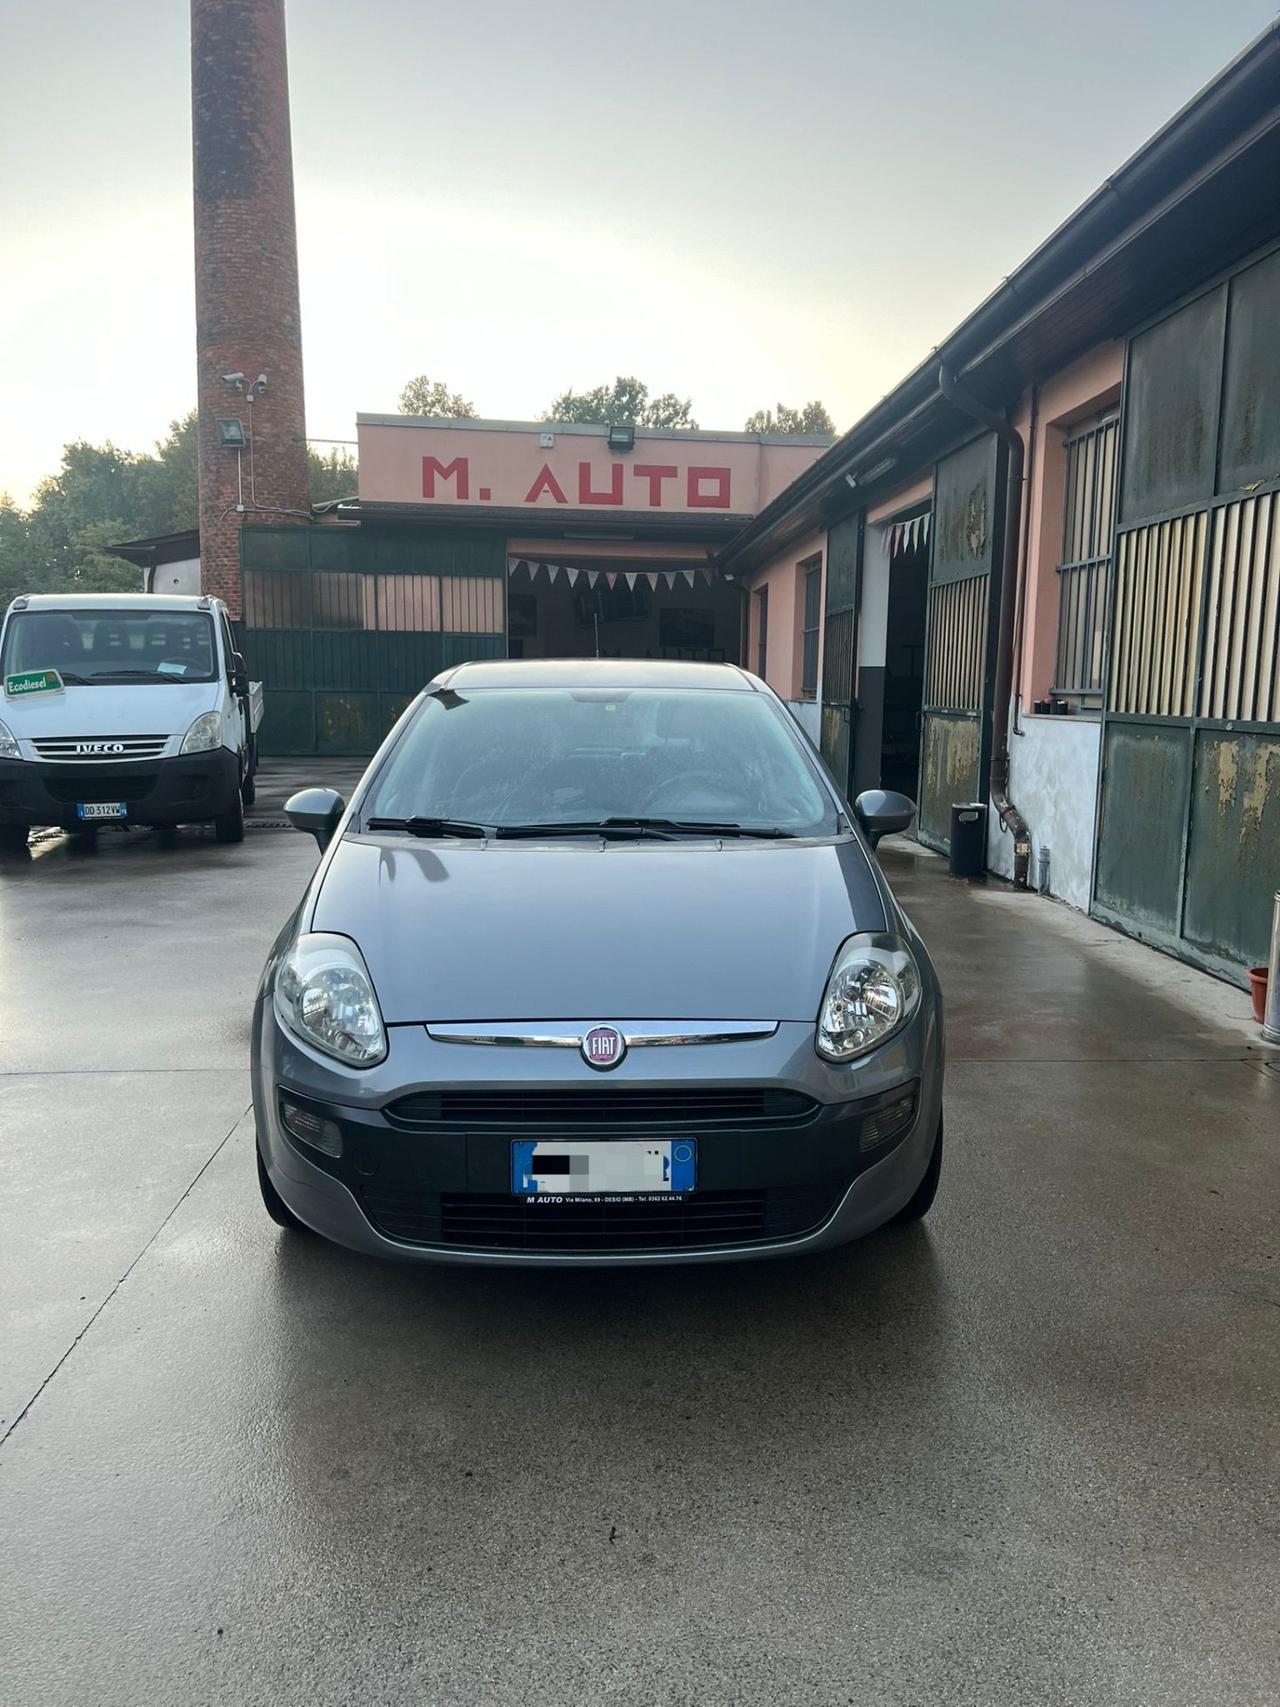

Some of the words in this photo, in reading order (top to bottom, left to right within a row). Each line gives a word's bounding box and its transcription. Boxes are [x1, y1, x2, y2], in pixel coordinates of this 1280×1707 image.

[422, 456, 491, 500] M.
[524, 462, 731, 508] AUTO
[8, 676, 47, 692] Ecodiesel
[76, 744, 124, 754] IVECO
[592, 1037, 615, 1055] FIAT
